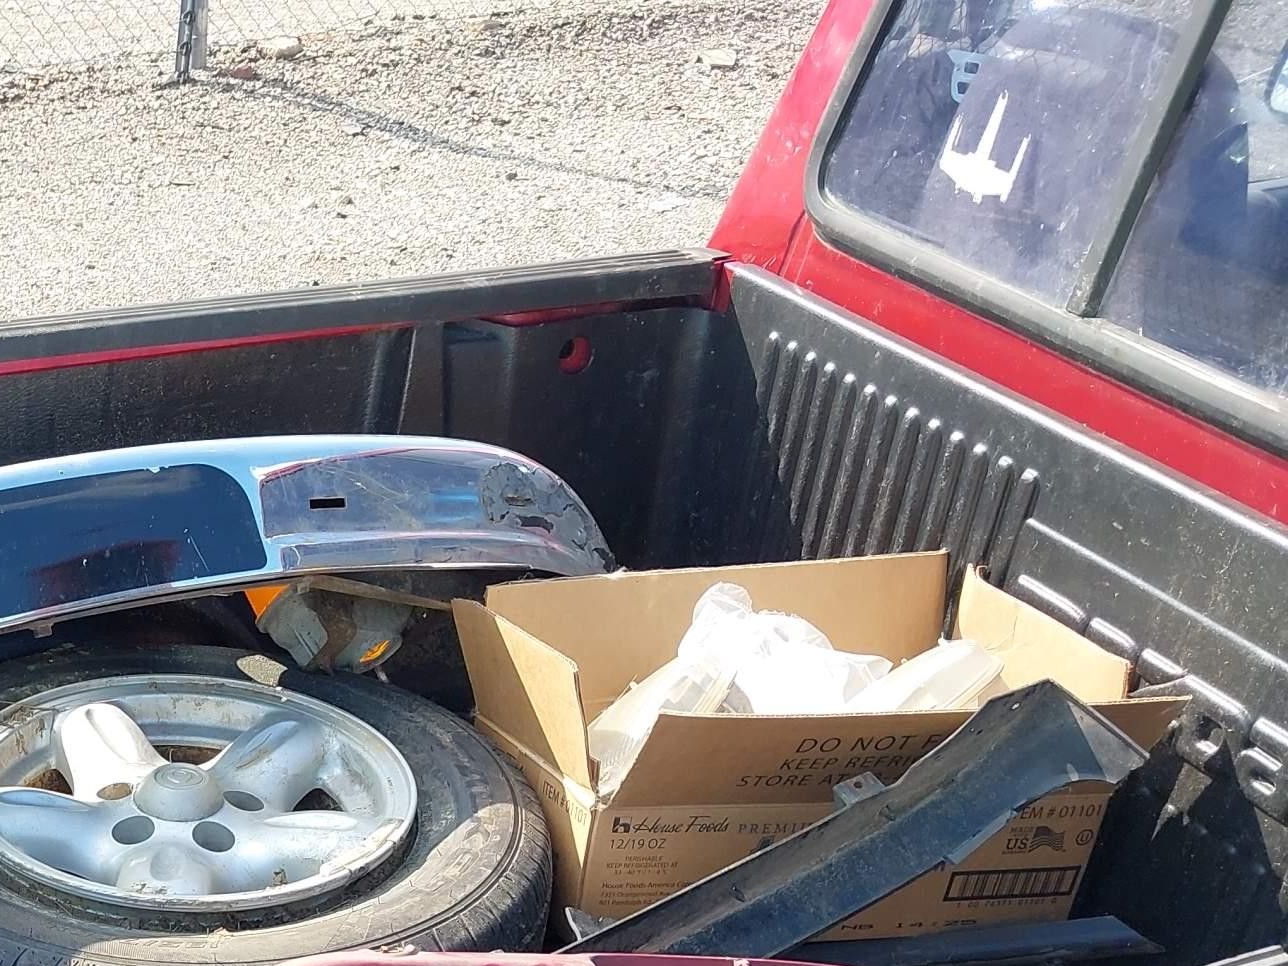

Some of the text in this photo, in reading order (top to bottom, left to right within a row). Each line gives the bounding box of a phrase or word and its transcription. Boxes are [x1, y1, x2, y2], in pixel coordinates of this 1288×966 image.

[795, 737, 842, 753] DO
[850, 734, 917, 752] NOT
[778, 757, 839, 771] KEEP
[735, 774, 813, 787] STORE
[543, 780, 560, 805] ITEM
[632, 816, 682, 833] House
[684, 814, 730, 833] Foods
[609, 837, 667, 850] 12/19 OZ
